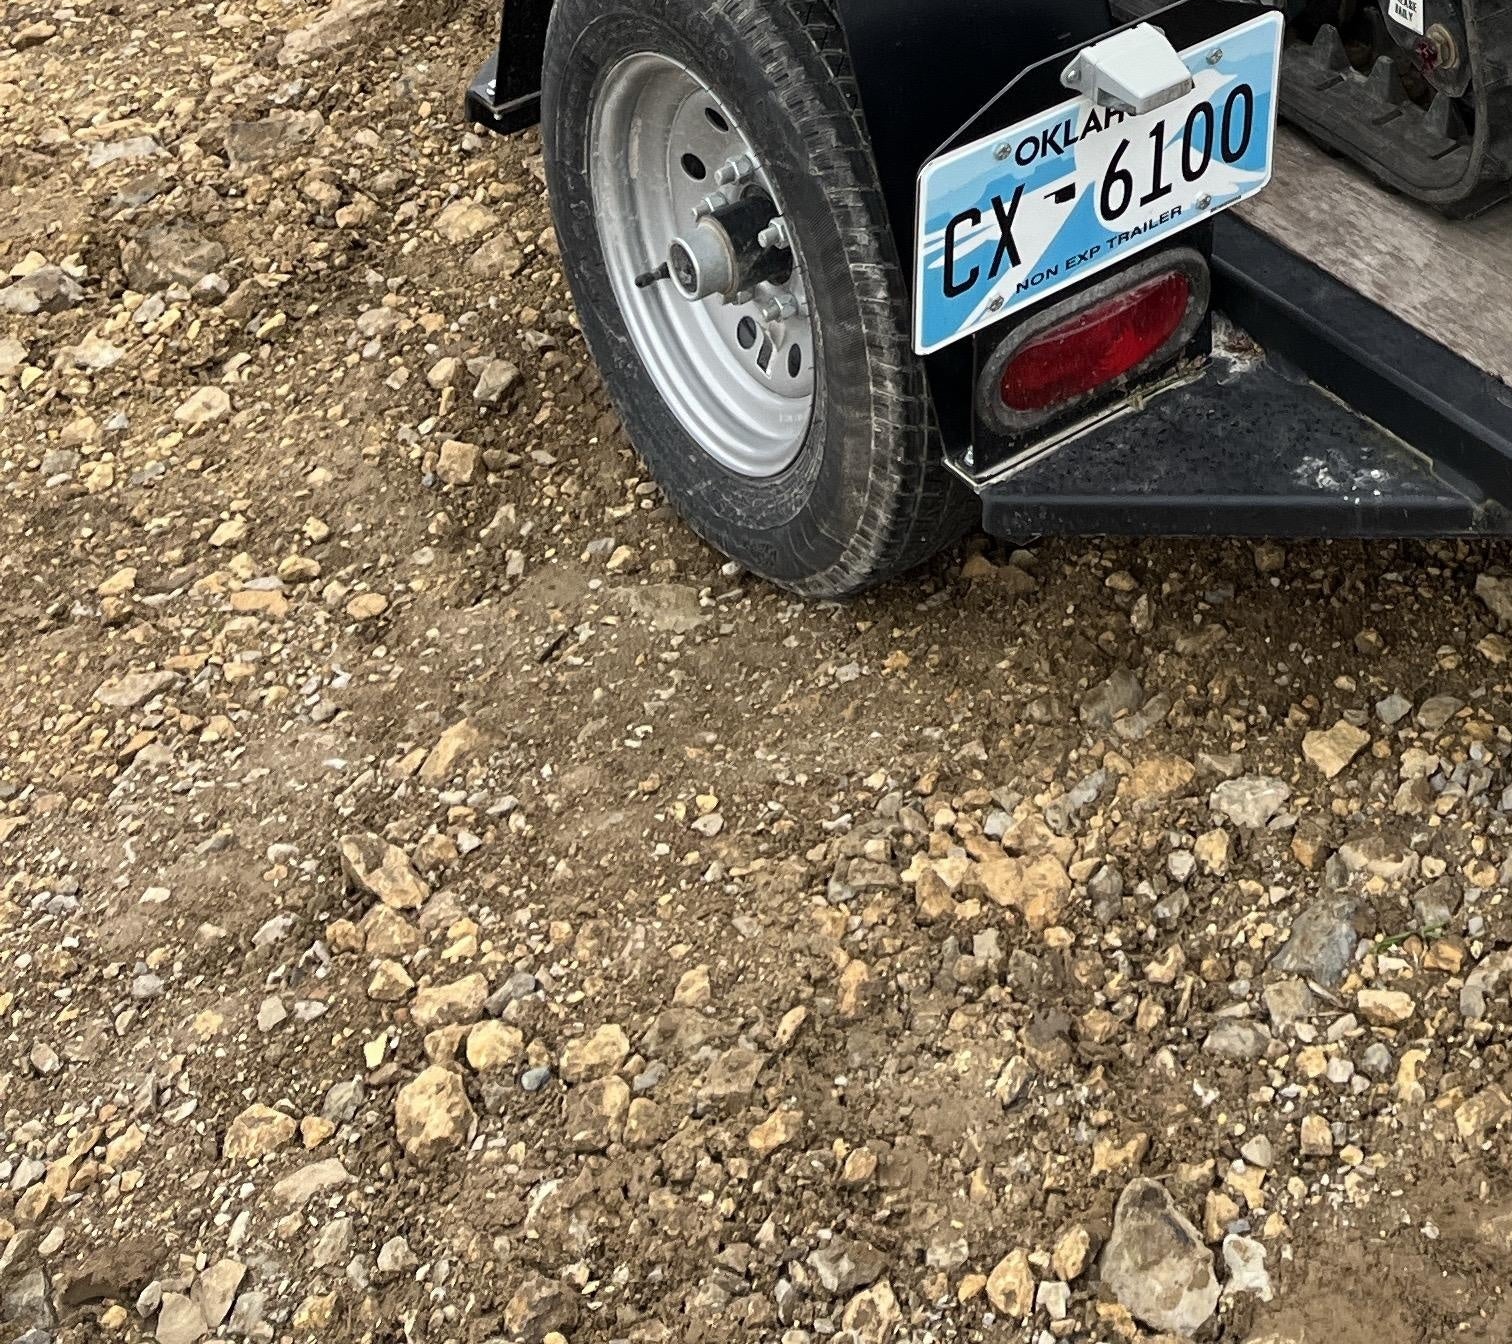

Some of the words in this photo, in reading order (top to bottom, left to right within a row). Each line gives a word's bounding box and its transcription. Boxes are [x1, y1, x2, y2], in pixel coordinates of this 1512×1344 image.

[1014, 107, 1137, 166] OKLAH
[943, 183, 1026, 298] CX
[1099, 83, 1253, 222] 6100
[1015, 265, 1059, 294] NON
[1065, 245, 1101, 271] EXP
[1106, 205, 1182, 250] TRAILER
